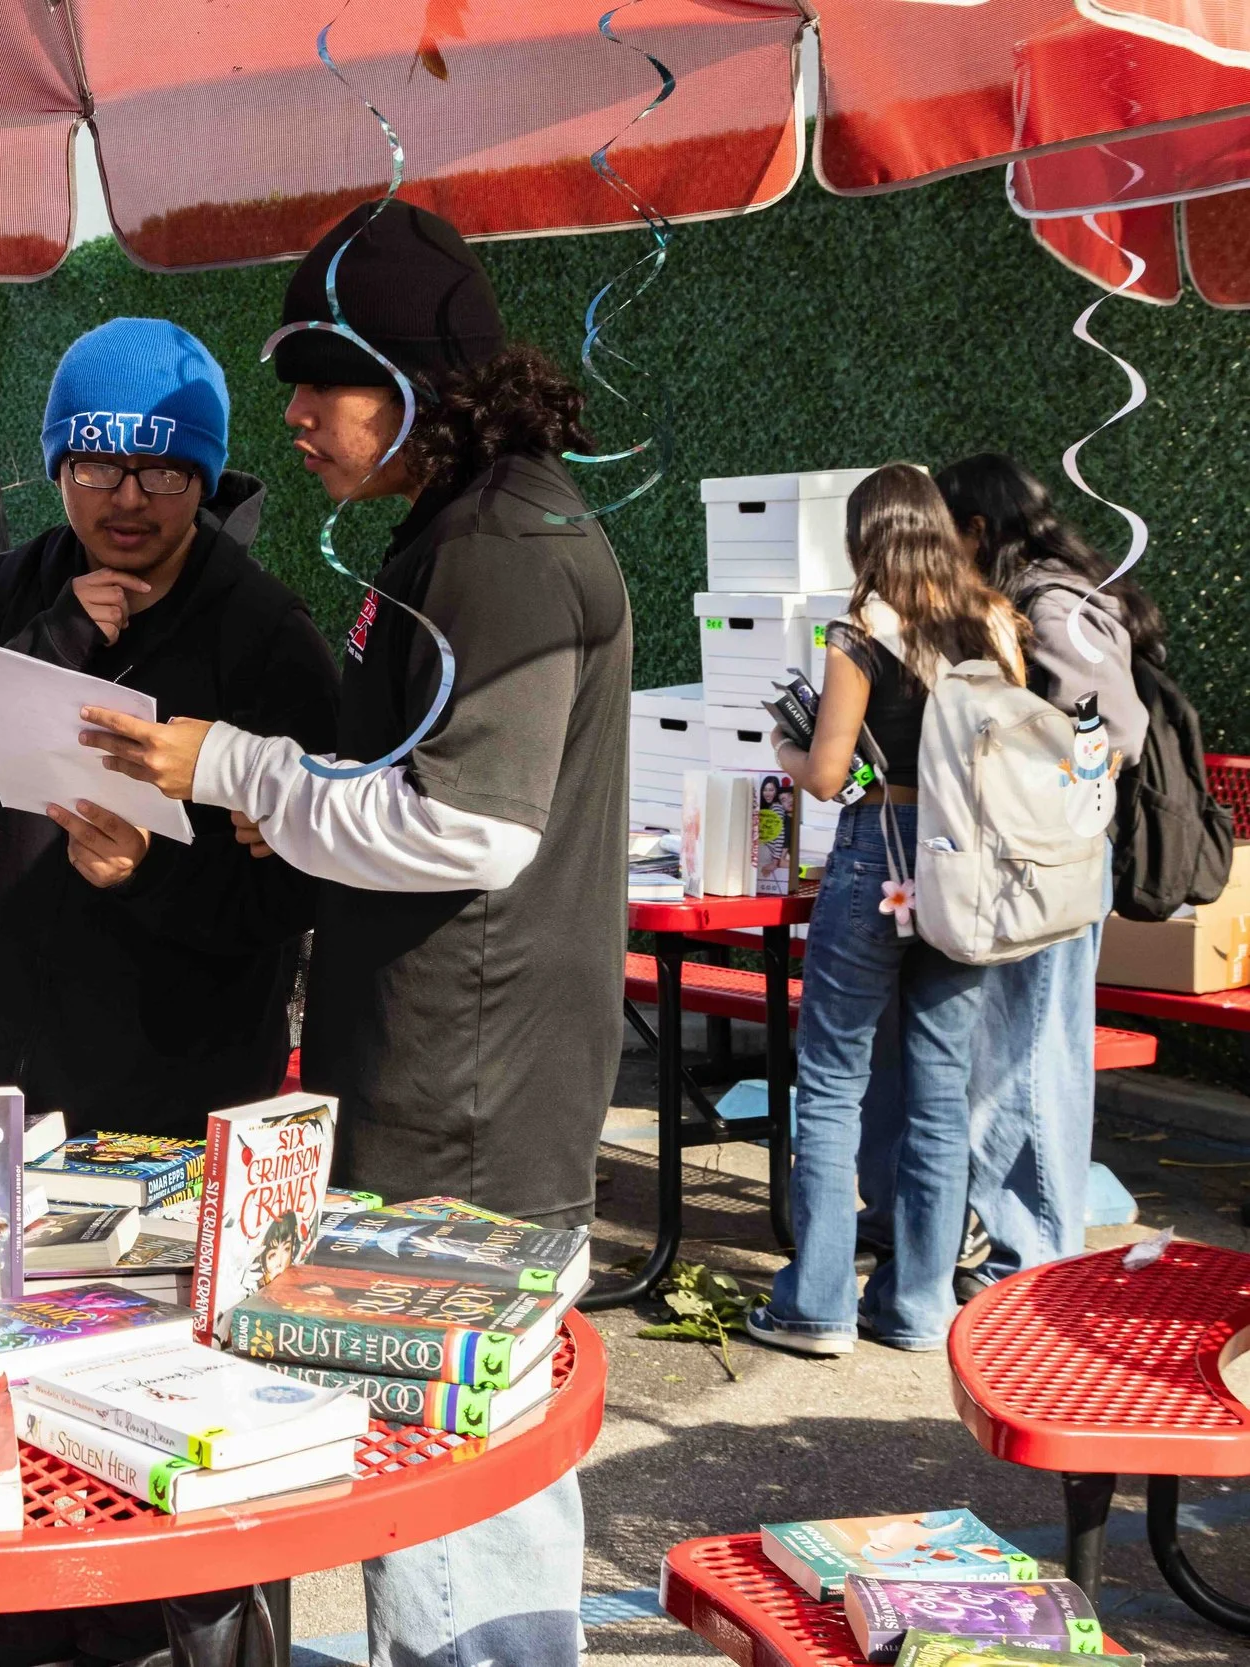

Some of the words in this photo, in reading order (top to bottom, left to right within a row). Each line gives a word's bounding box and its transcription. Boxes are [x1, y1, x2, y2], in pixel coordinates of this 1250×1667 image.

[68, 411, 176, 456] MU
[275, 1124, 309, 1152] SIX
[148, 1175, 167, 1195] OMAR
[168, 1168, 185, 1186] EPPS
[247, 1143, 322, 1186] CRIMSON
[204, 1177, 220, 1208] SIX
[240, 1170, 318, 1239] CRANES
[198, 1207, 218, 1277] CRIMSON
[193, 1276, 212, 1333] CRANES
[347, 1279, 426, 1316] RUST
[406, 1306, 431, 1317] IN
[418, 1287, 450, 1304] THE
[421, 1286, 507, 1326] ROOT
[238, 1315, 249, 1351] IRELAND
[278, 1322, 348, 1359] RUST
[350, 1338, 362, 1355] IN
[365, 1333, 379, 1364] THE
[381, 1335, 445, 1371] ROO
[363, 1378, 425, 1415] ROO
[56, 1431, 105, 1474] STOLEN
[108, 1450, 139, 1491] HEIR
